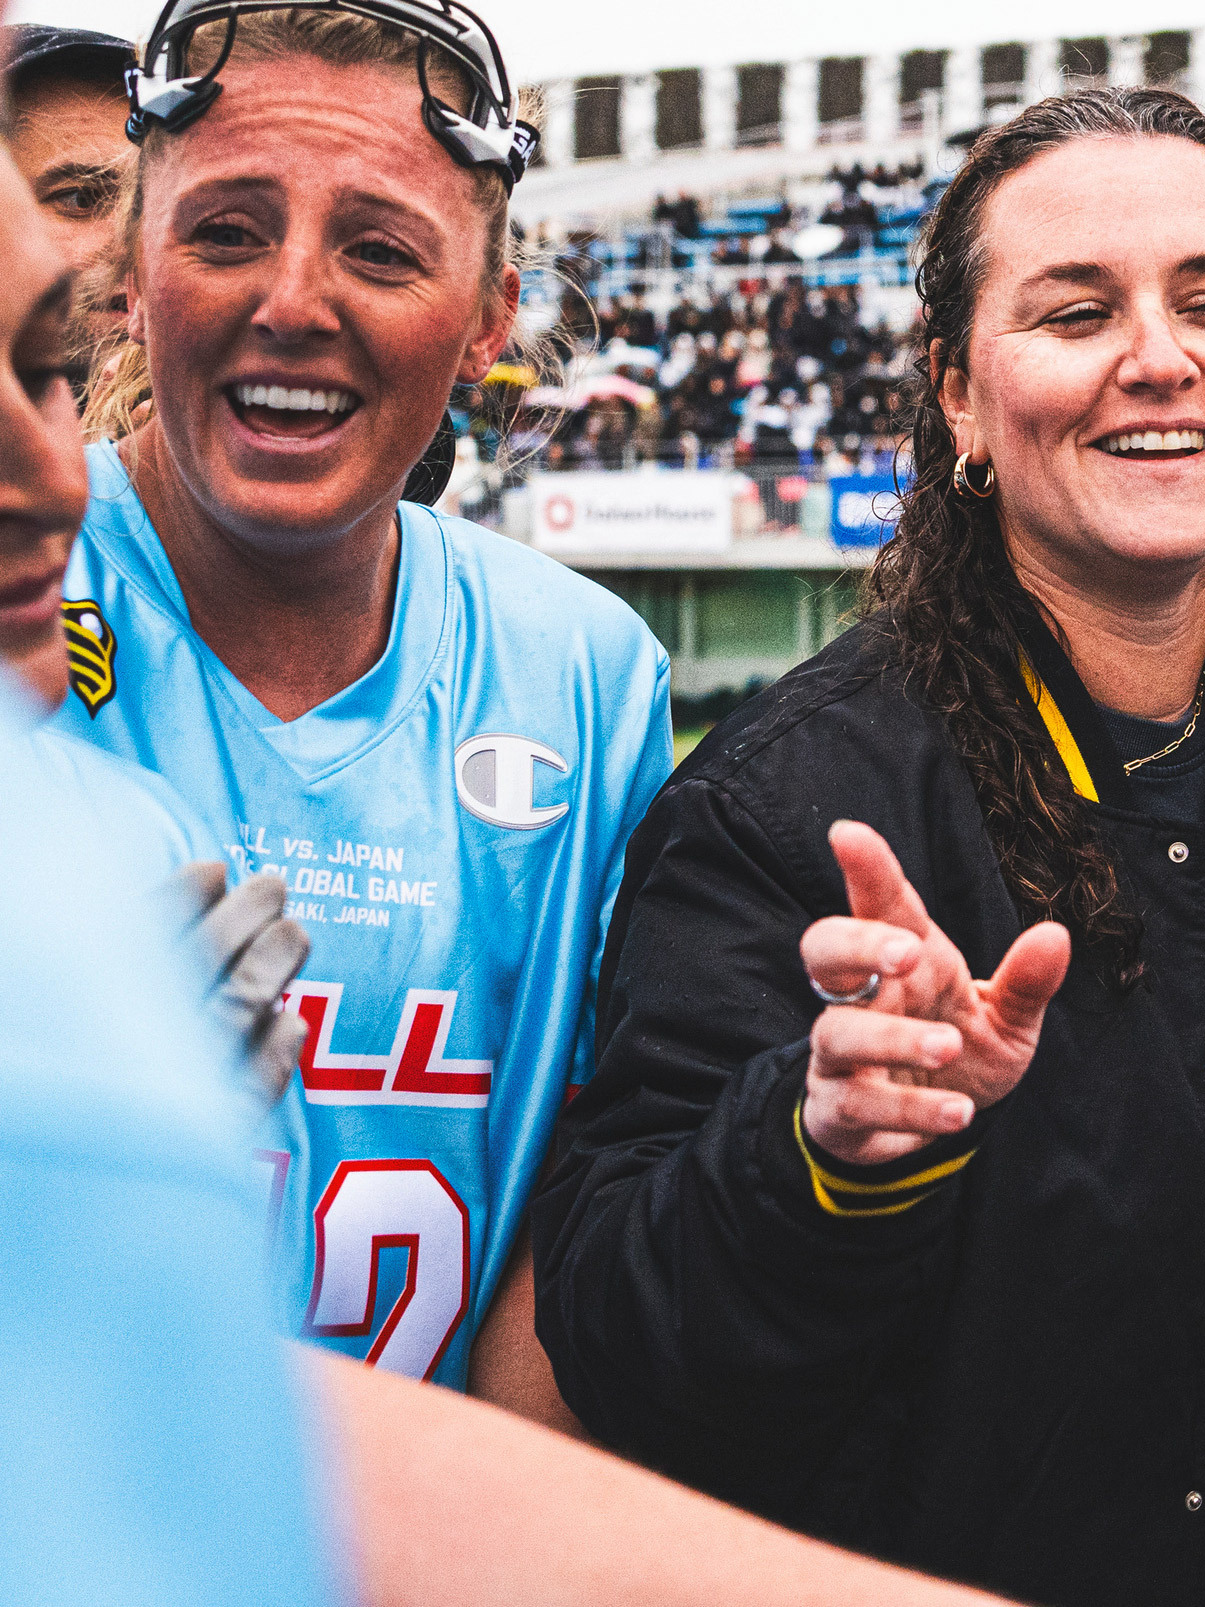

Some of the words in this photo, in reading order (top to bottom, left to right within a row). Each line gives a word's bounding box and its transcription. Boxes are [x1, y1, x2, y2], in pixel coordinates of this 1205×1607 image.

[327, 839, 404, 873] JAPAN
[368, 876, 438, 907] GAME
[284, 901, 328, 924] SAKI,
[333, 906, 390, 928] JAPAN
[274, 979, 494, 1108] LL
